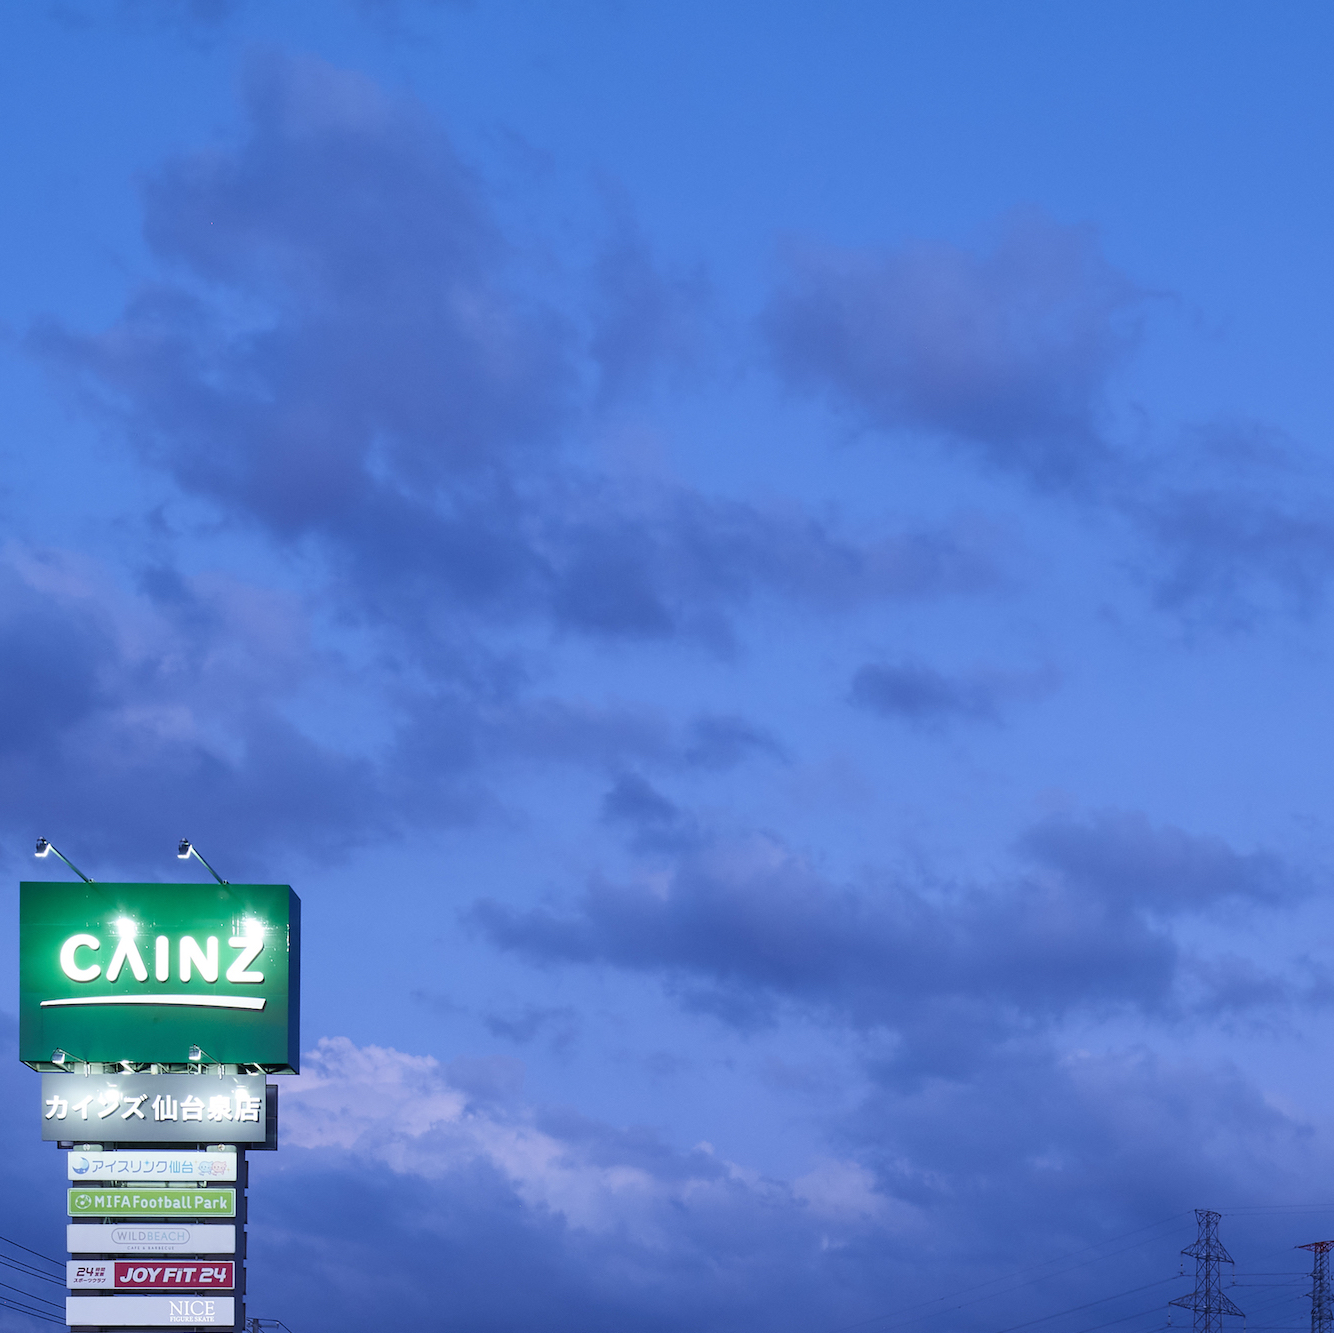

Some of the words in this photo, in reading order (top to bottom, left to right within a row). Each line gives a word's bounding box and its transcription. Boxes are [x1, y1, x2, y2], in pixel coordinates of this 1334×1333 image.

[59, 933, 265, 984] CAINZ
[92, 1160, 194, 1174] アイスリンク仙台
[94, 1195, 131, 1208] MIFA
[133, 1195, 192, 1208] Football
[195, 1195, 227, 1208] Park
[198, 1267, 227, 1283] 24
[169, 1300, 216, 1316] NICE
